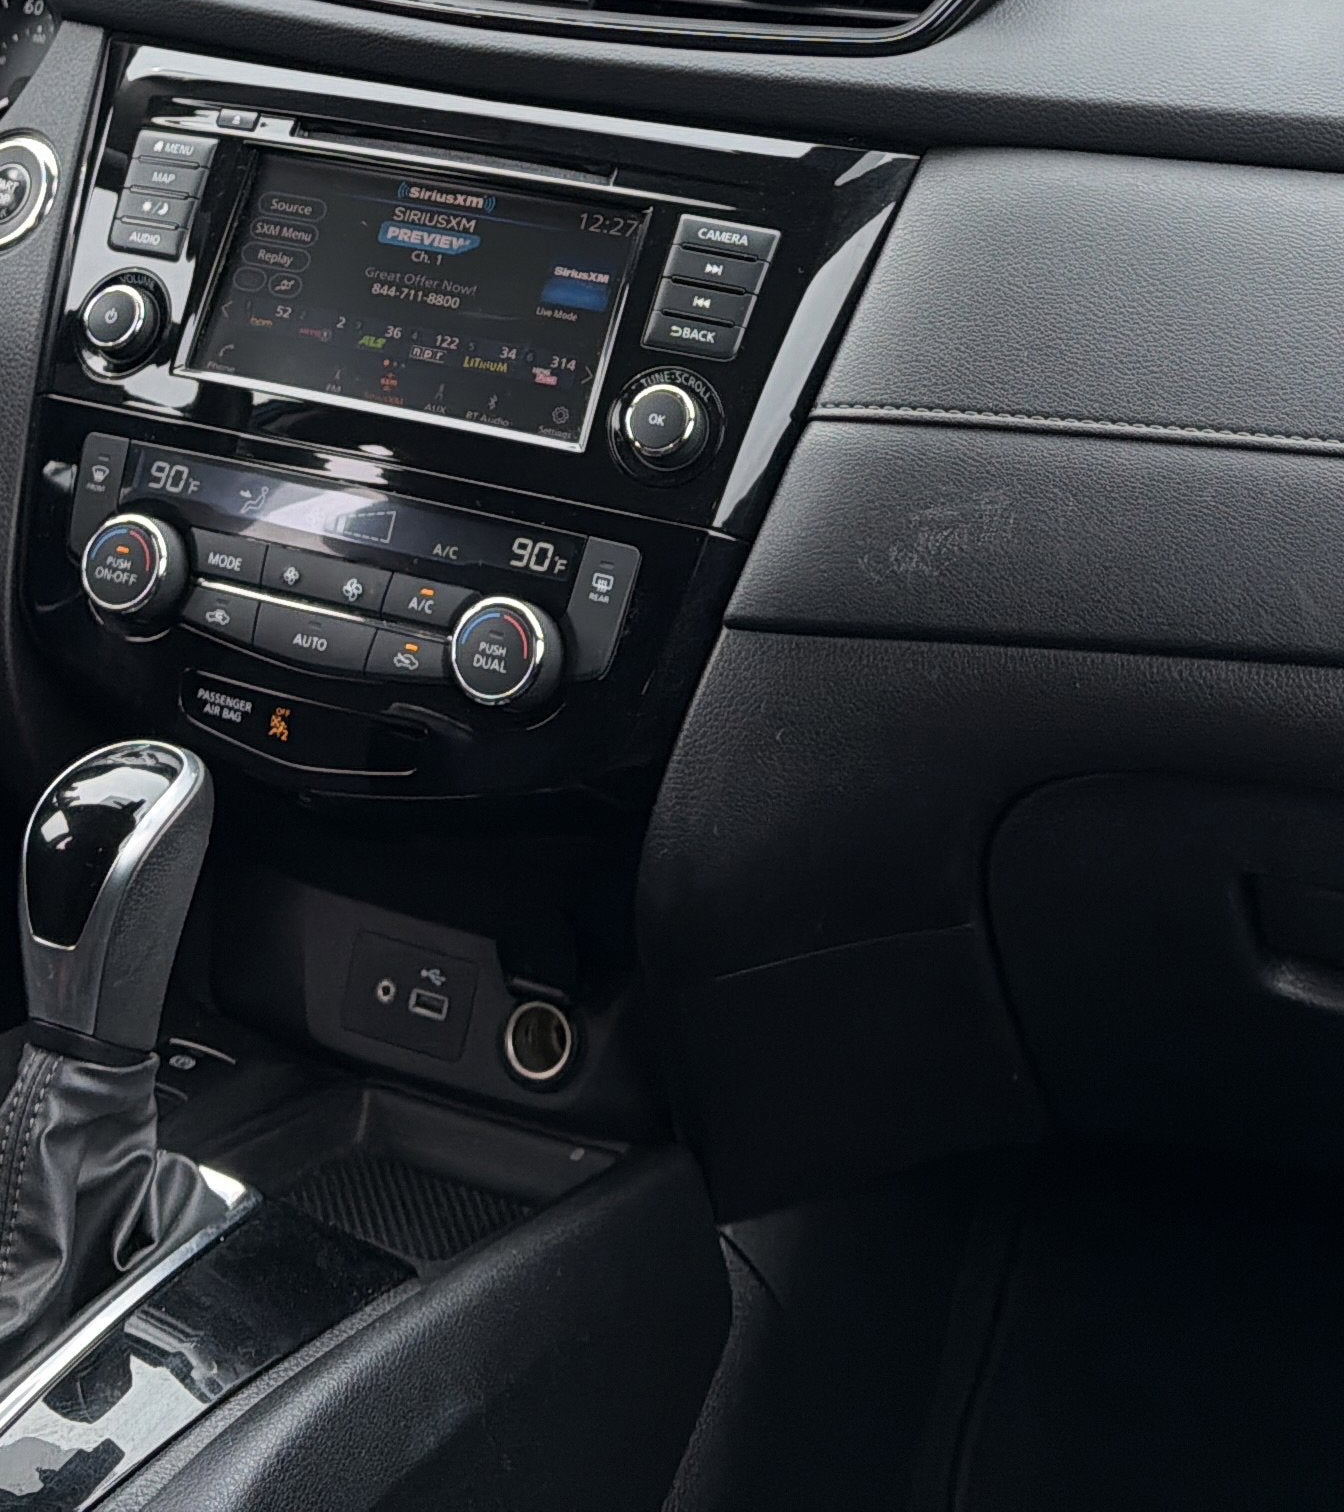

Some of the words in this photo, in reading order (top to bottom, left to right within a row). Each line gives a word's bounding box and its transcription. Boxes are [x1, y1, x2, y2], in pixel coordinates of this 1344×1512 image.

[23, 0, 44, 16] 60
[165, 142, 194, 156] MENU
[152, 172, 176, 184] MAP
[270, 198, 313, 216] Source
[393, 206, 478, 233] SIRIUSXM
[579, 212, 640, 238] 12:27
[129, 231, 161, 246] AUDIO
[256, 222, 280, 235] SXM
[281, 224, 312, 242] Menu
[386, 226, 472, 250] PREVIEW
[698, 228, 749, 246] CAMERA
[257, 249, 294, 268] Replay
[364, 266, 401, 284] Great
[403, 272, 440, 290] Offer
[371, 282, 461, 310] 844-711-8800
[275, 304, 292, 319] 52
[337, 316, 346, 329] 2
[384, 325, 402, 339] 36
[682, 327, 716, 343] BACK
[435, 334, 460, 350] 122
[411, 346, 445, 362] npr
[499, 346, 517, 360] 34
[550, 355, 577, 371] 314
[649, 413, 666, 426] OK
[432, 543, 459, 560] A/C
[106, 555, 132, 571] PUSH
[208, 552, 243, 572] MODE
[408, 596, 435, 614] A/C
[588, 593, 610, 604] REAR
[293, 633, 328, 652] AUTO
[478, 641, 507, 657] PUSH
[472, 654, 508, 674] DUAL
[197, 688, 253, 713] PASSENGER
[204, 703, 221, 716] AIR
[222, 707, 242, 723] BAG
